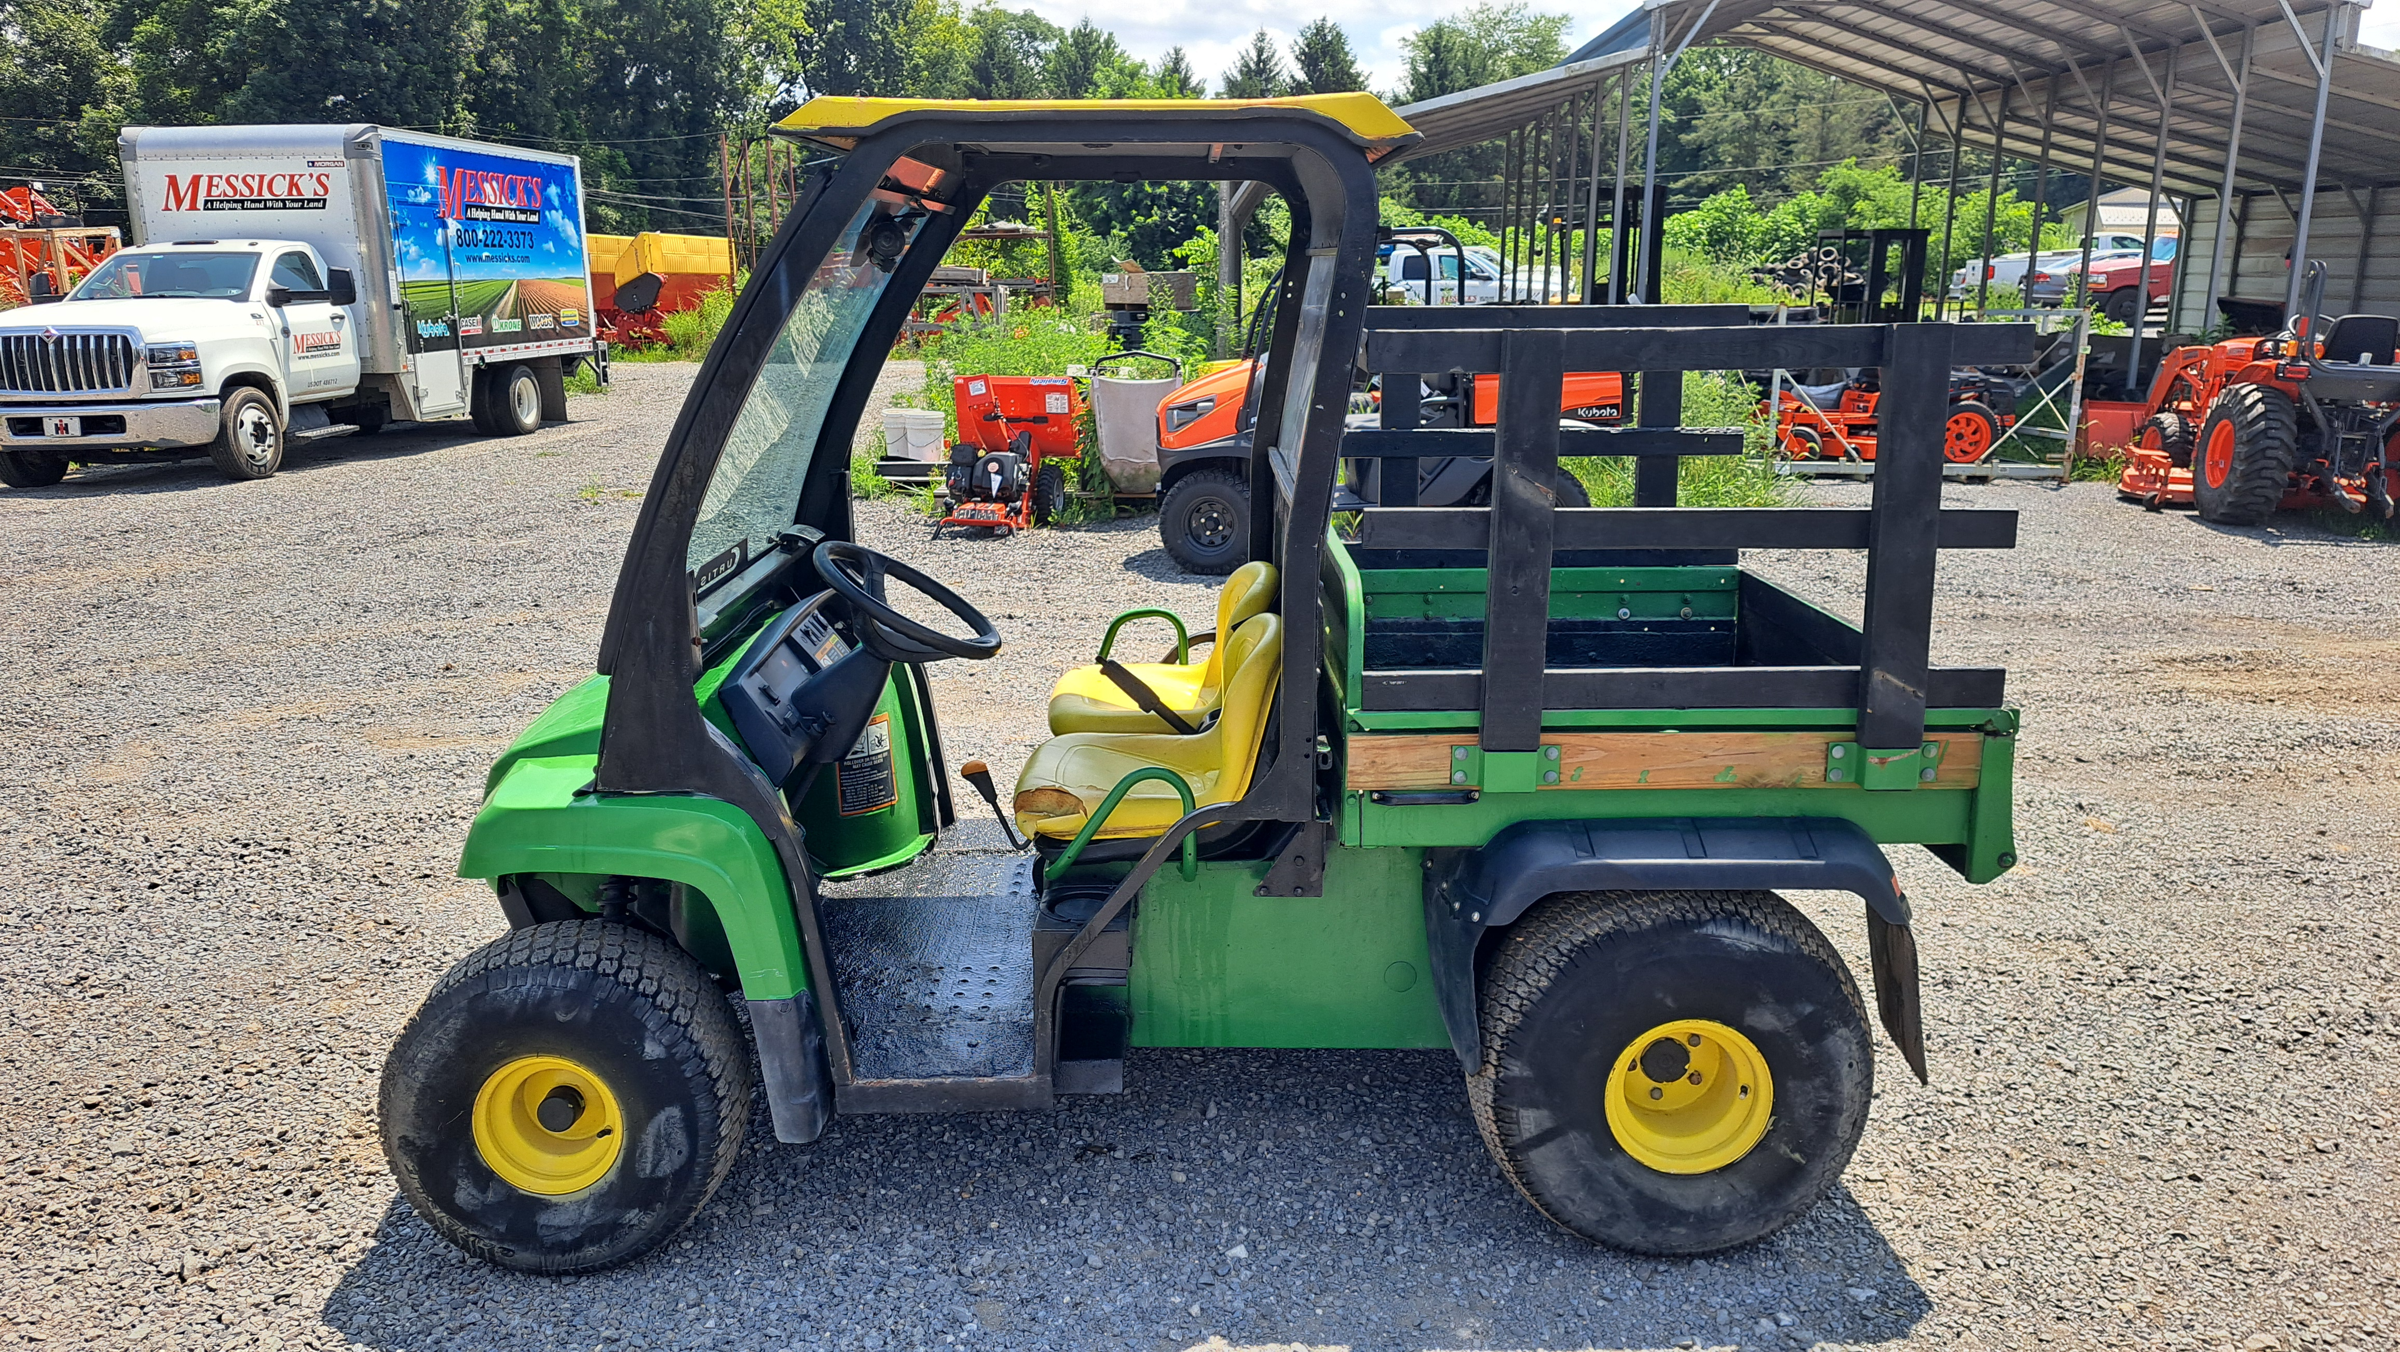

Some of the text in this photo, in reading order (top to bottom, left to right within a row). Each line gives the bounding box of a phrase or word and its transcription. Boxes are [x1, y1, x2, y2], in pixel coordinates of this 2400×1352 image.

[162, 172, 330, 212] MESSICK'S
[437, 166, 542, 220] MESSICK'S
[205, 199, 323, 210] A Helping Hand With Your Land
[466, 208, 539, 222] A Helping Hand With Your Land
[456, 228, 535, 249] 800-222-3373
[465, 252, 531, 263] www.messicks.com
[500, 320, 521, 331] KRONE
[529, 314, 553, 329] WOODS
[293, 331, 341, 354] MESSICK'S
[1578, 407, 1618, 417] Kubota
